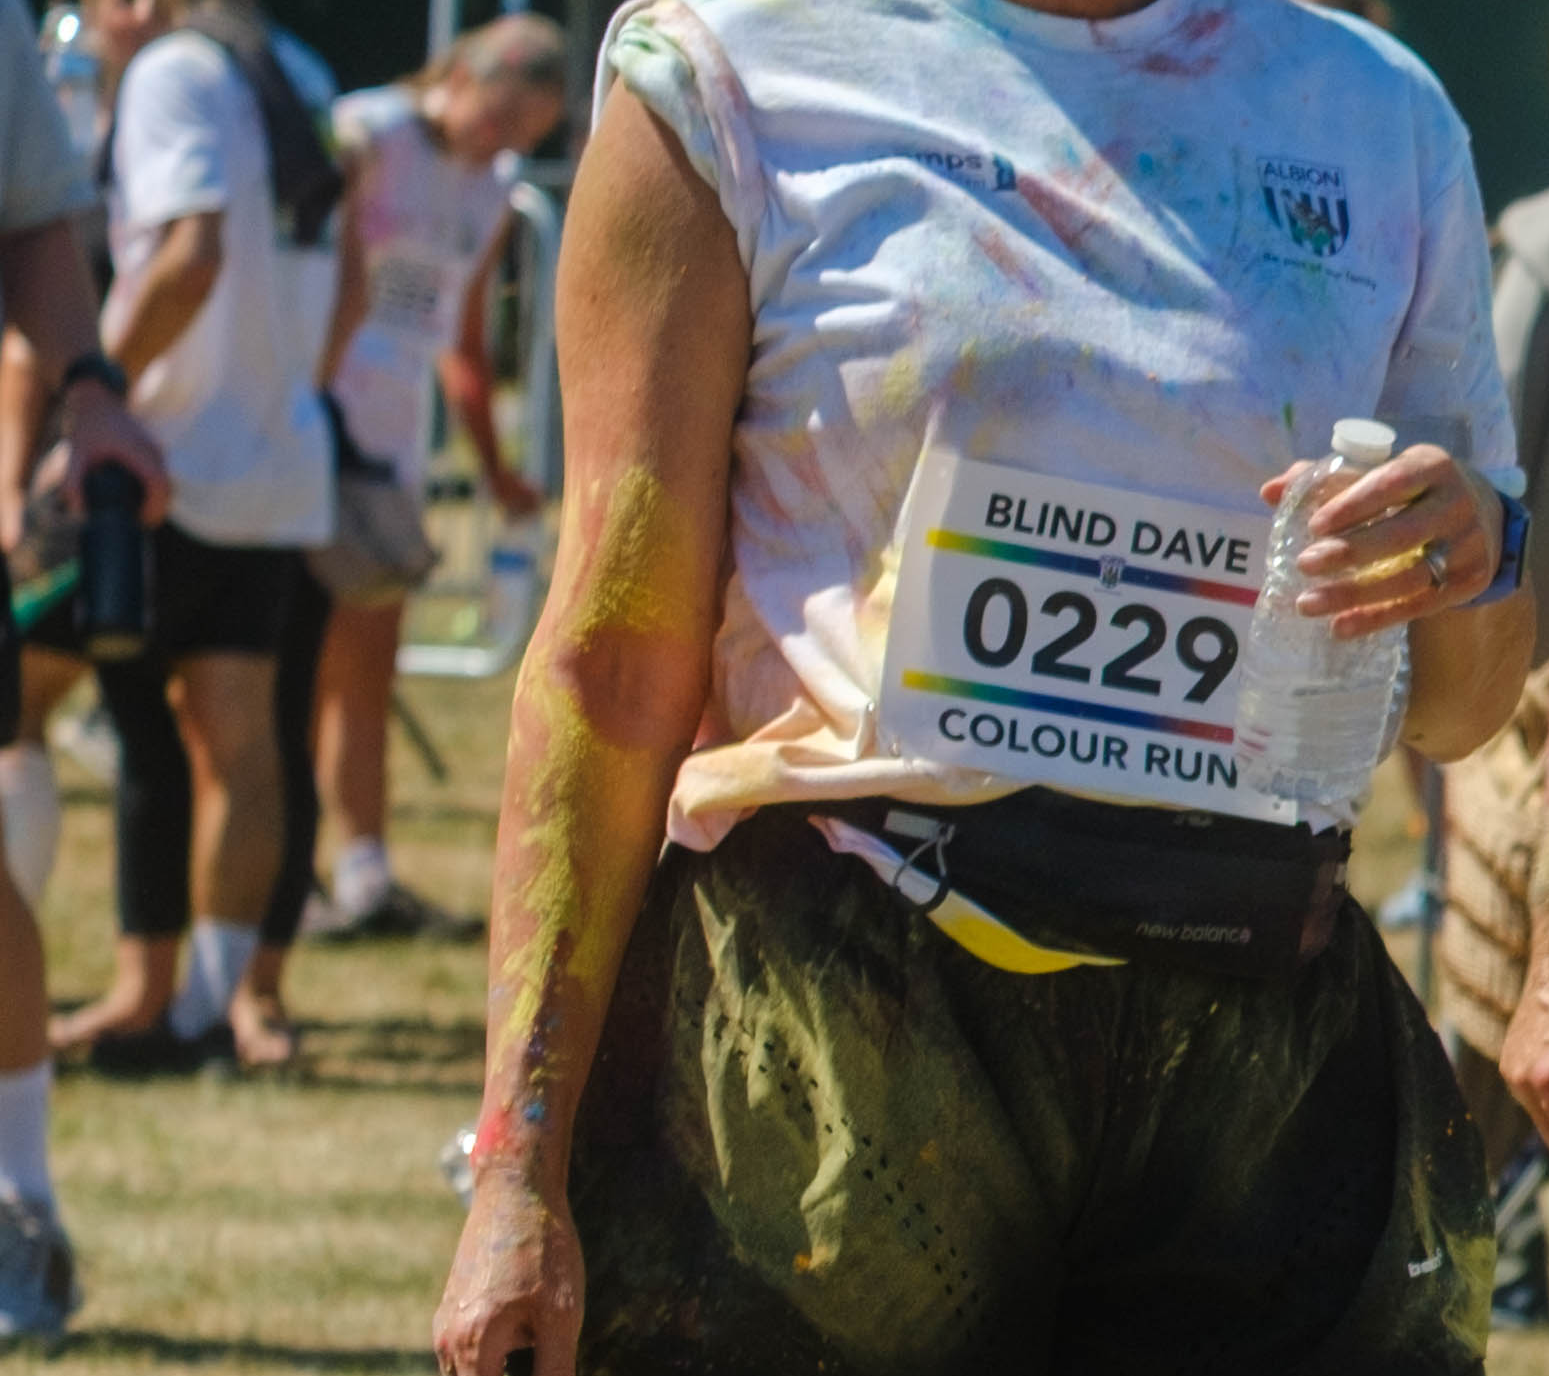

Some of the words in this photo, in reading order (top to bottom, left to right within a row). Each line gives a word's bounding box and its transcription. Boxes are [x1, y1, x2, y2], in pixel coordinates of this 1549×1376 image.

[1264, 162, 1340, 187] ALBION
[984, 492, 1117, 547] BLIND
[1130, 520, 1252, 575] DAVE
[963, 576, 1240, 704] 0229
[938, 707, 1130, 770] COLOUR
[1144, 743, 1239, 790] RUN
[1136, 922, 1179, 940] new
[1181, 924, 1252, 945] balance
